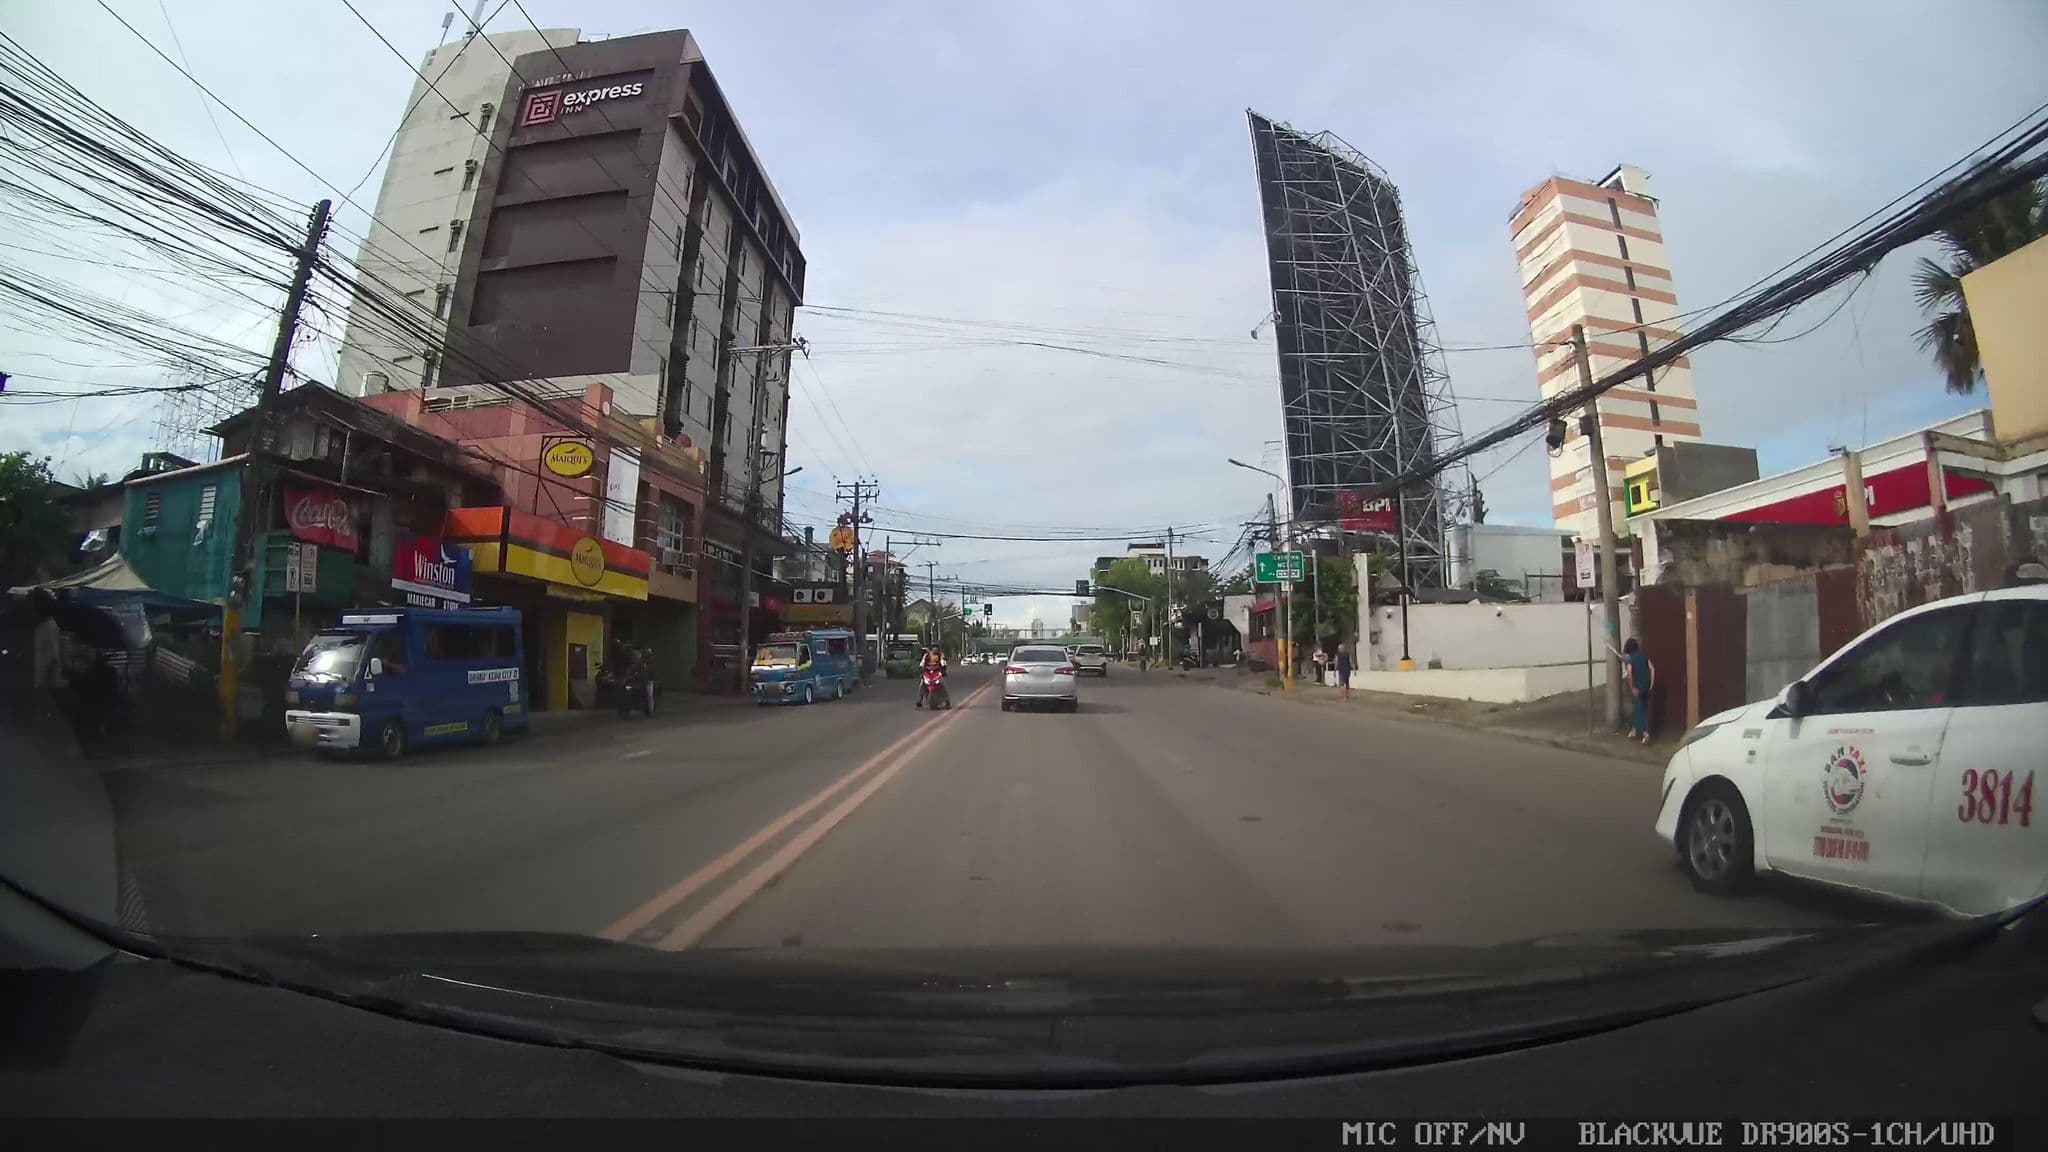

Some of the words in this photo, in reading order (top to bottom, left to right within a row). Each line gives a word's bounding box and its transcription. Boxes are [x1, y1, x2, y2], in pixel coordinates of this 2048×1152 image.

[563, 82, 643, 106] express
[560, 105, 582, 115] INN
[1362, 497, 1391, 512] BPI
[414, 549, 455, 585] Winston
[1958, 768, 2036, 827] 3814
